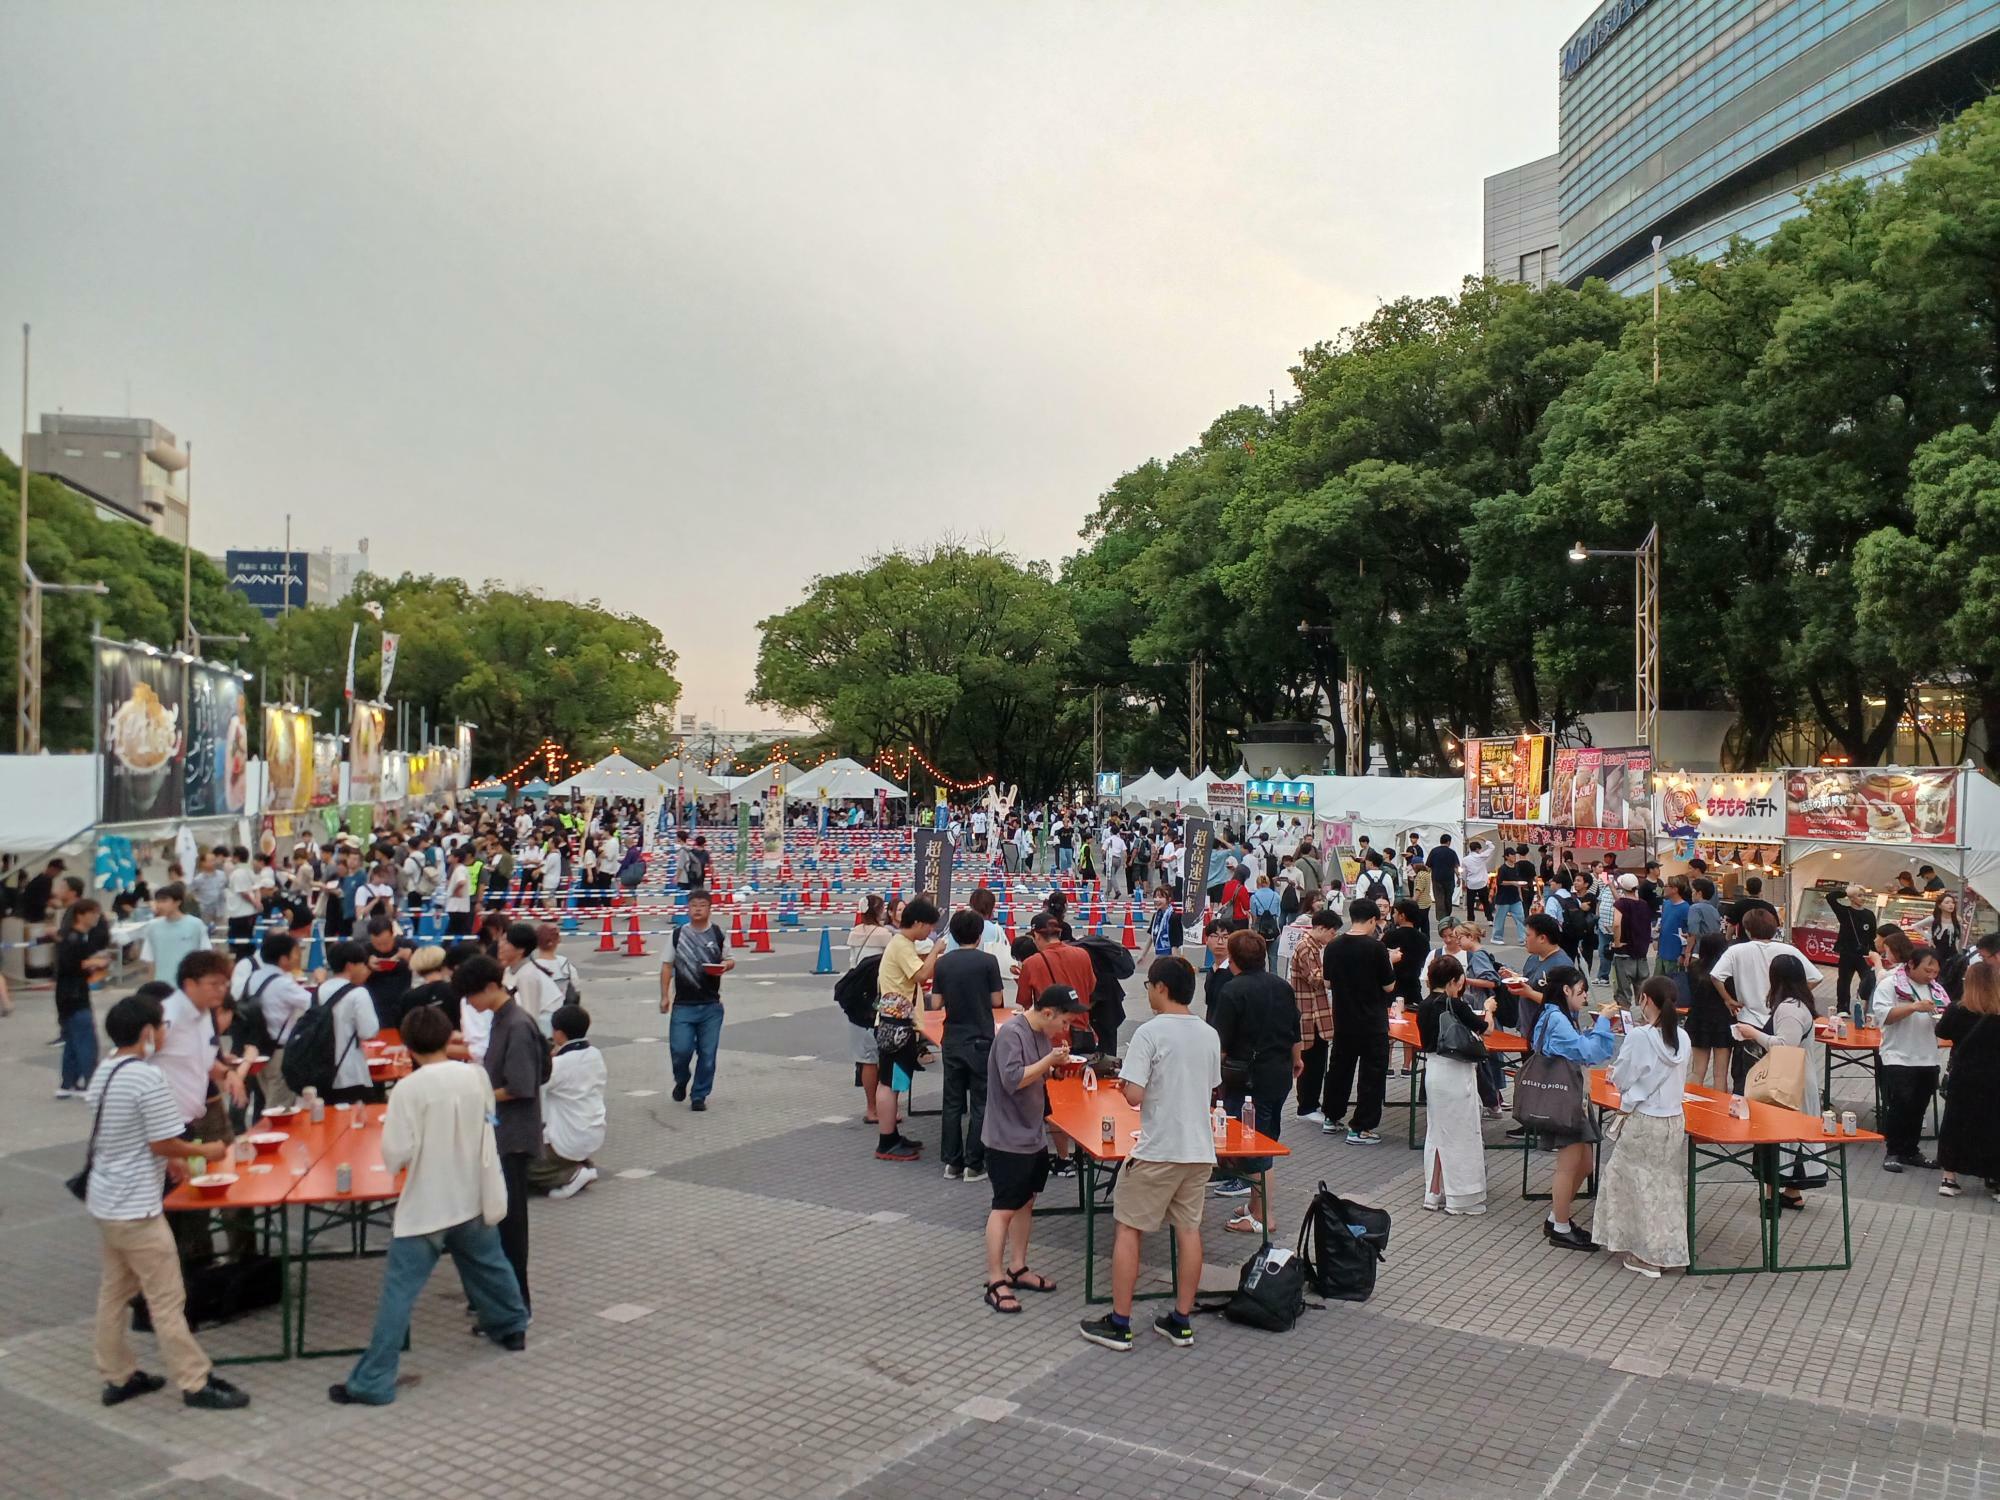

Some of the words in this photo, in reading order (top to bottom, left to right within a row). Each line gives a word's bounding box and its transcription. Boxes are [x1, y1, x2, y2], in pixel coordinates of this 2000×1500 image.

[1706, 797, 1778, 818] もちもちポテト
[923, 840, 942, 907] 超高速
[1185, 830, 1208, 913] 超高速回転
[1522, 1079, 1547, 1089] GELATO
[1547, 1083, 1569, 1091] PIQUE
[1754, 1069, 1768, 1082] GU
